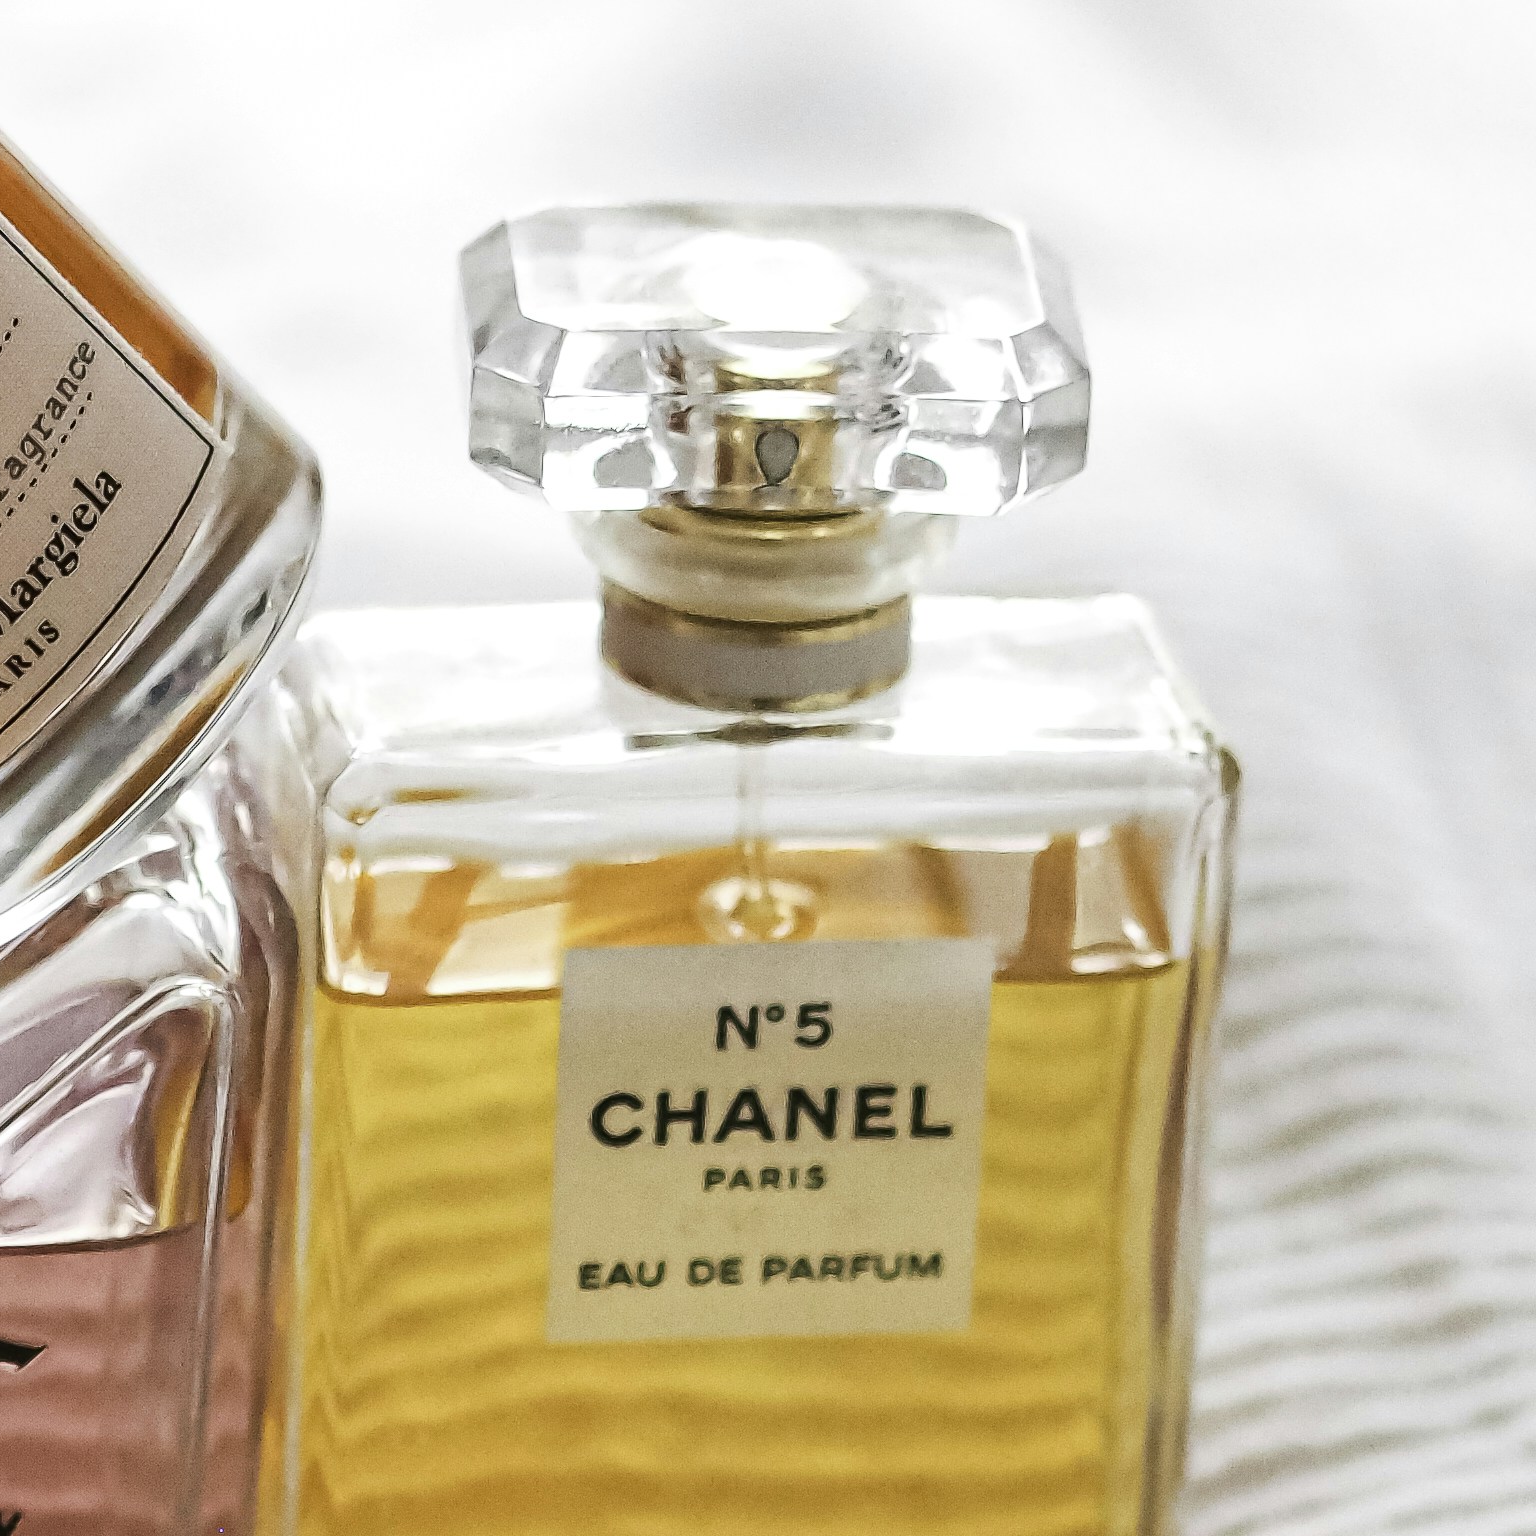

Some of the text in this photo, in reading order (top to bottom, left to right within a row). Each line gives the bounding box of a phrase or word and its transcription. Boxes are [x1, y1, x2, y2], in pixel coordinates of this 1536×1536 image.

[590, 1084, 953, 1148] CHANEL
[703, 1164, 826, 1192] PARIS
[578, 1252, 943, 1290] EAU DE PARFUM
